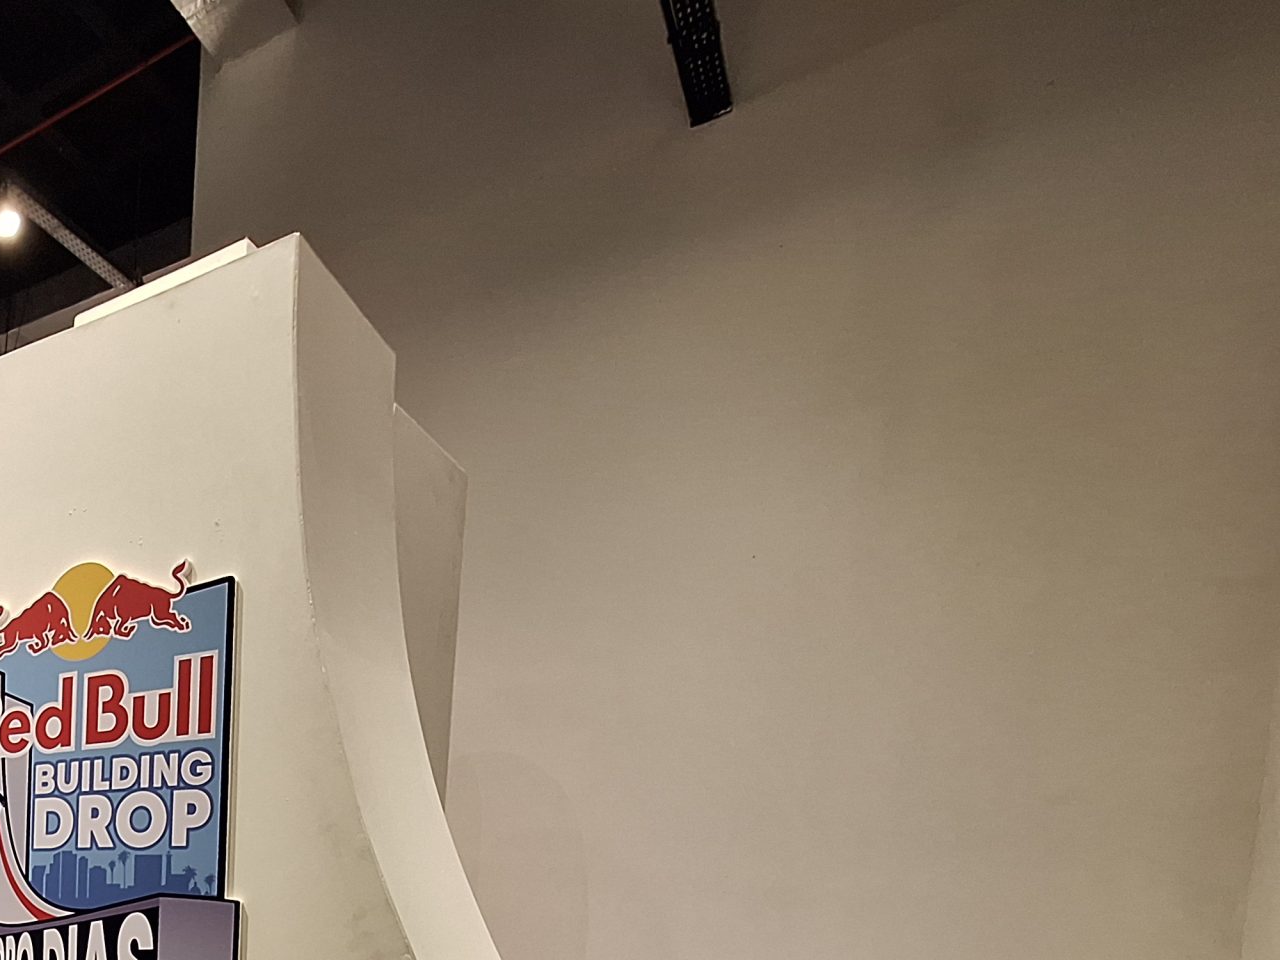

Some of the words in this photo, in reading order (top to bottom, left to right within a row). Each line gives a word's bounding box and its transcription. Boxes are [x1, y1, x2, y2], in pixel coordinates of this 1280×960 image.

[85, 655, 214, 745] Bull
[34, 751, 213, 794] BUILDING
[33, 790, 212, 850] DROP
